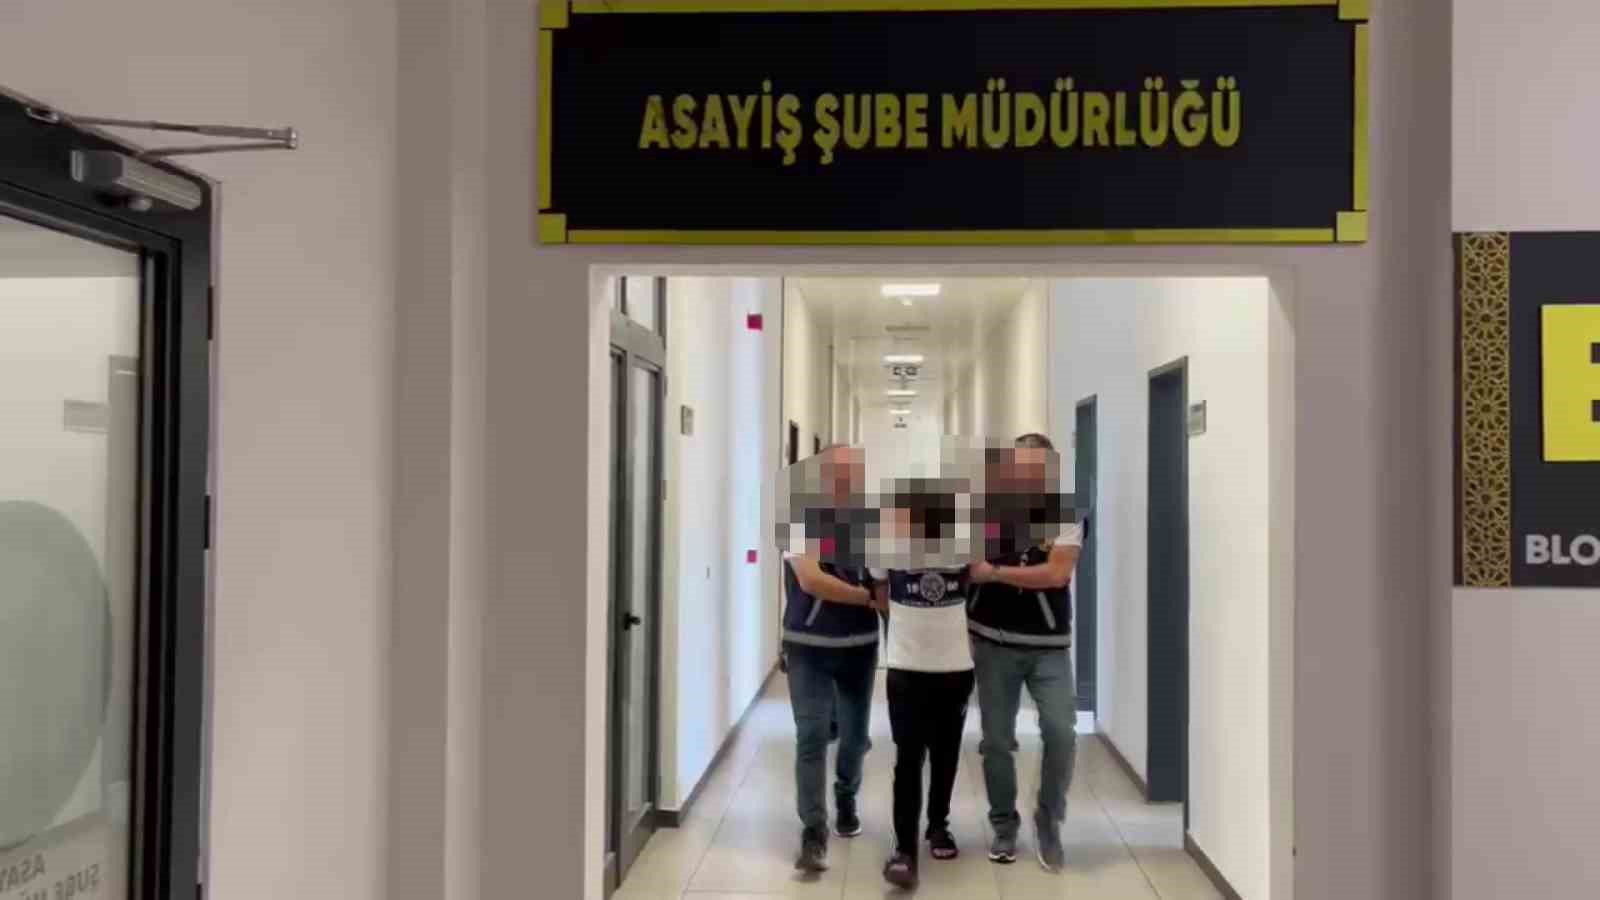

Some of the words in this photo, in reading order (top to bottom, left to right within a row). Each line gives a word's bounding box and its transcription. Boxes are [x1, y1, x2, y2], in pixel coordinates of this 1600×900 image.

[638, 79, 801, 165] ASAYİŞ
[813, 94, 929, 165] ŞUBE
[941, 76, 1241, 150] MÜDÜRLÜĞÜ
[1525, 534, 1600, 566] BLO
